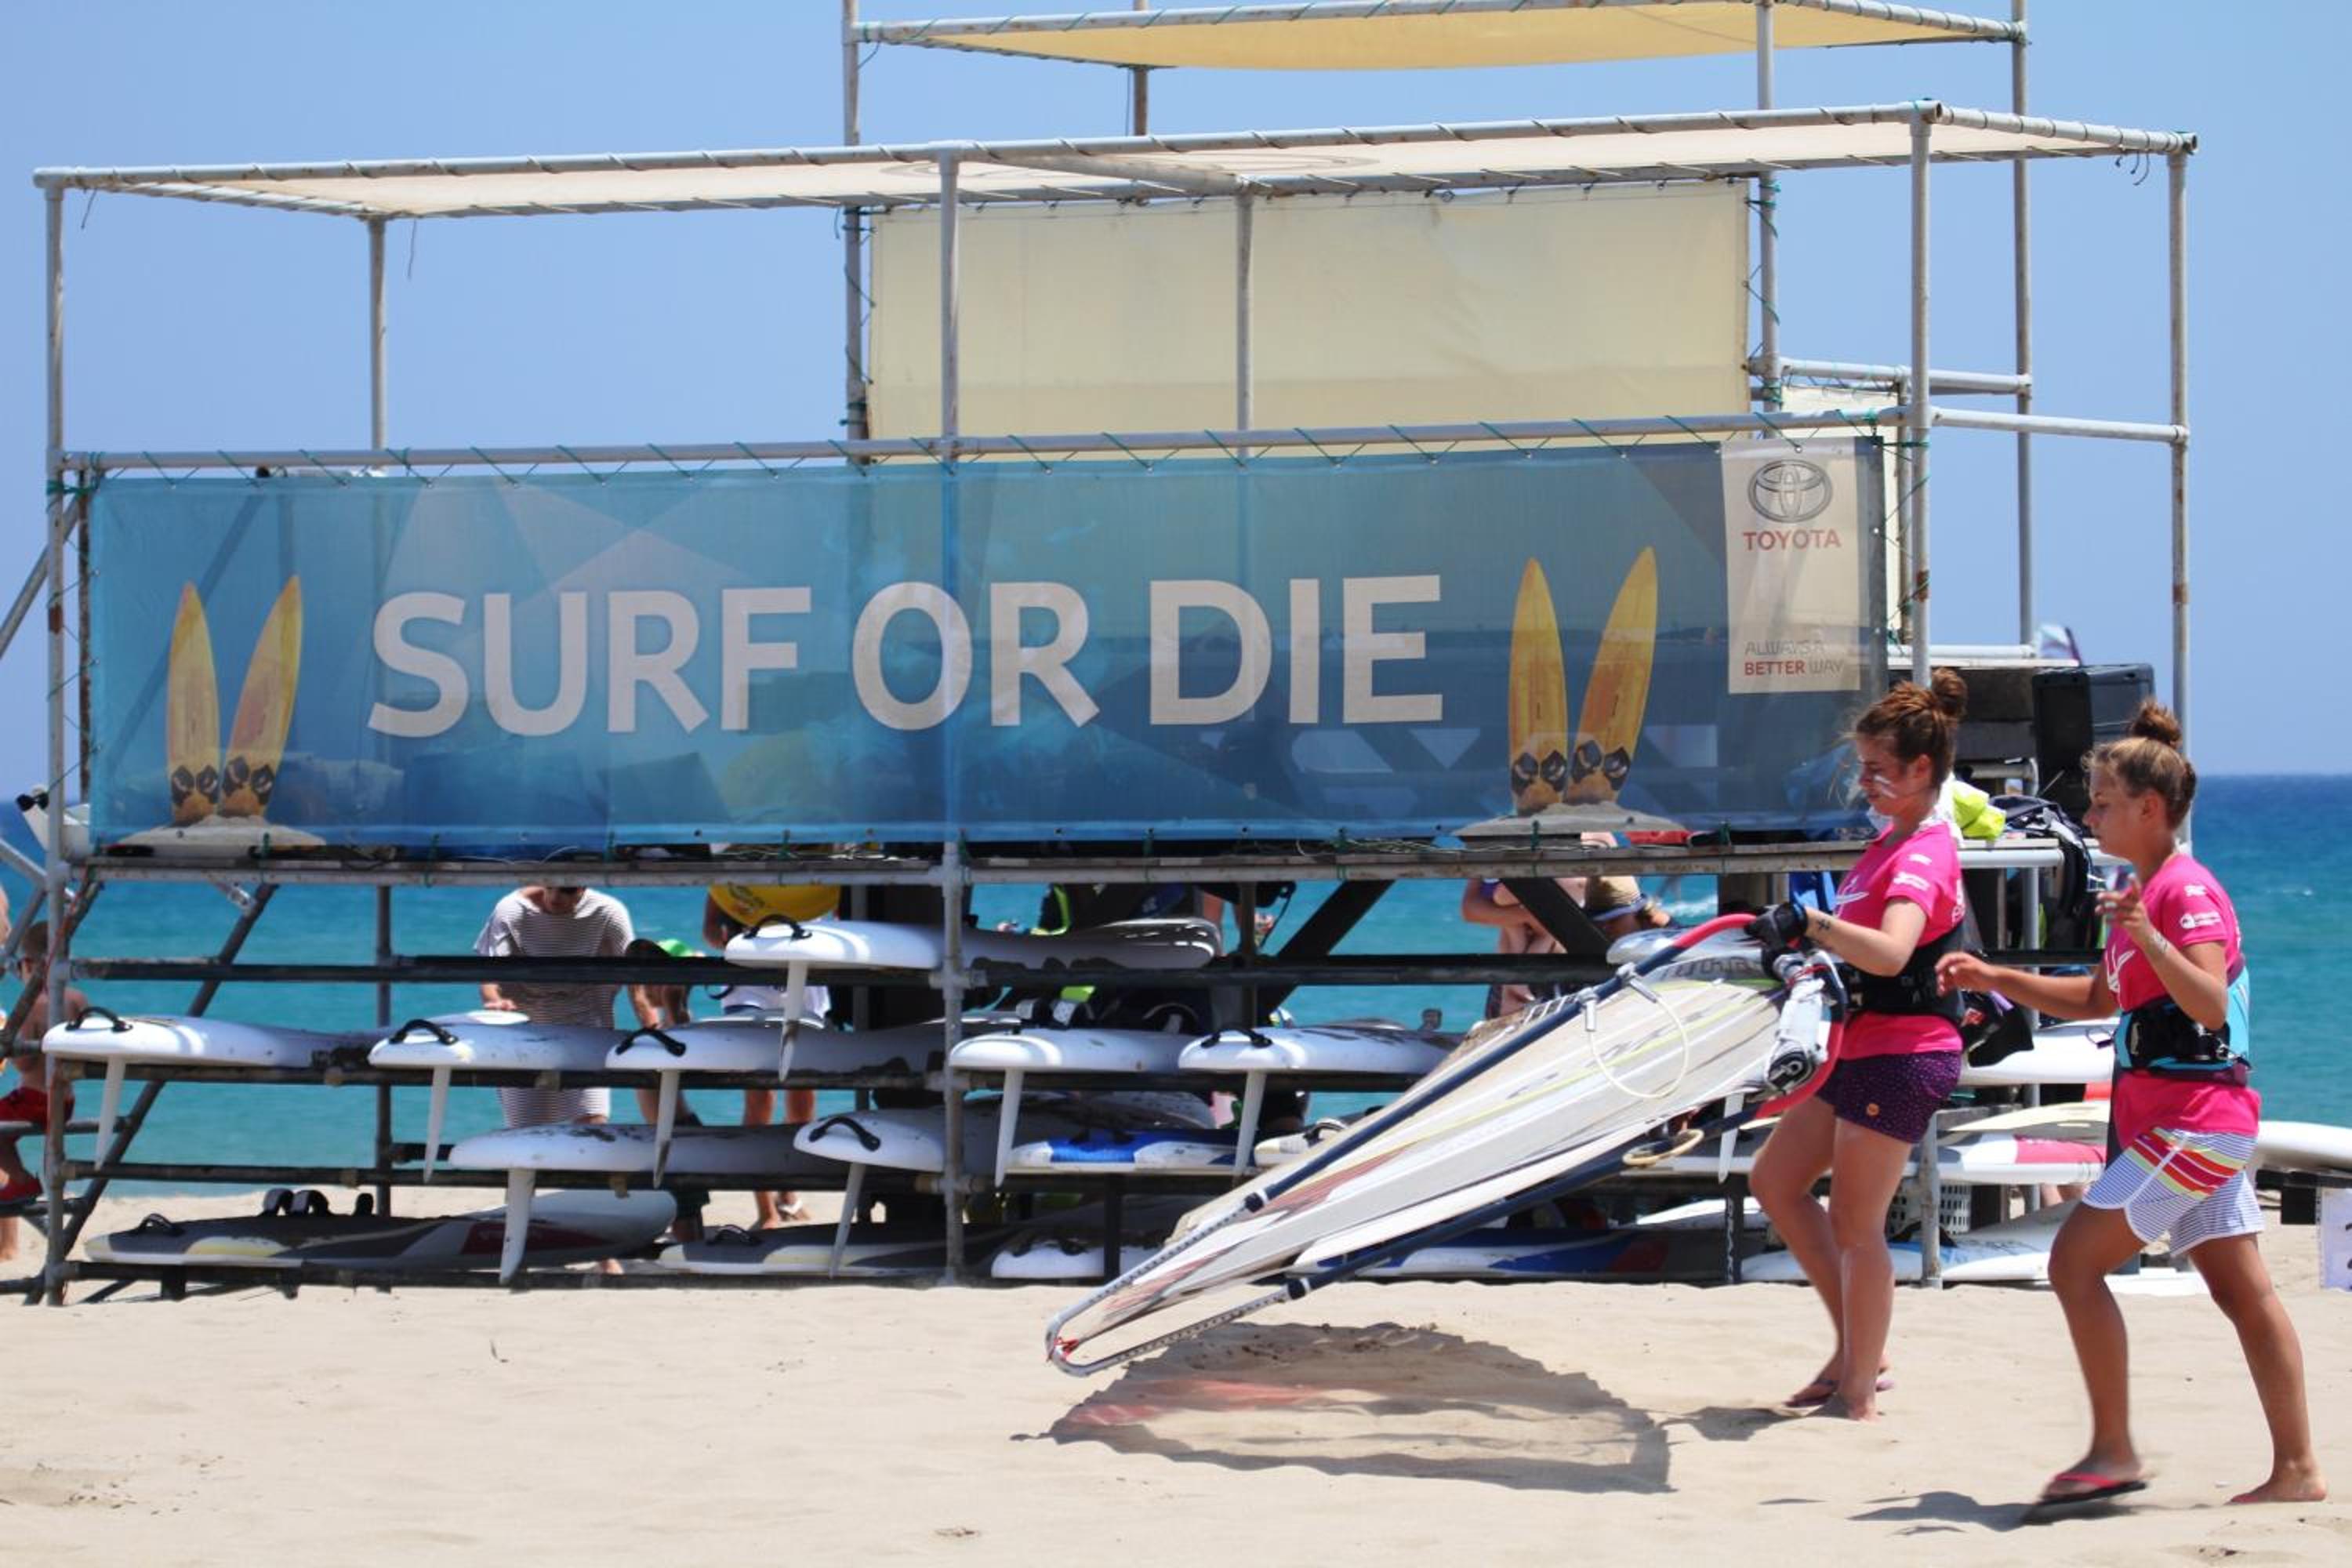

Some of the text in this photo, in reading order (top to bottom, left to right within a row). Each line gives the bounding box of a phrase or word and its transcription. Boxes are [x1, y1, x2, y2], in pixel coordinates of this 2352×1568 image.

[1743, 529, 1841, 550] TOYOTA
[366, 575, 1443, 738] SURF OR DIE
[1744, 659, 1843, 676] BETTER WAY
